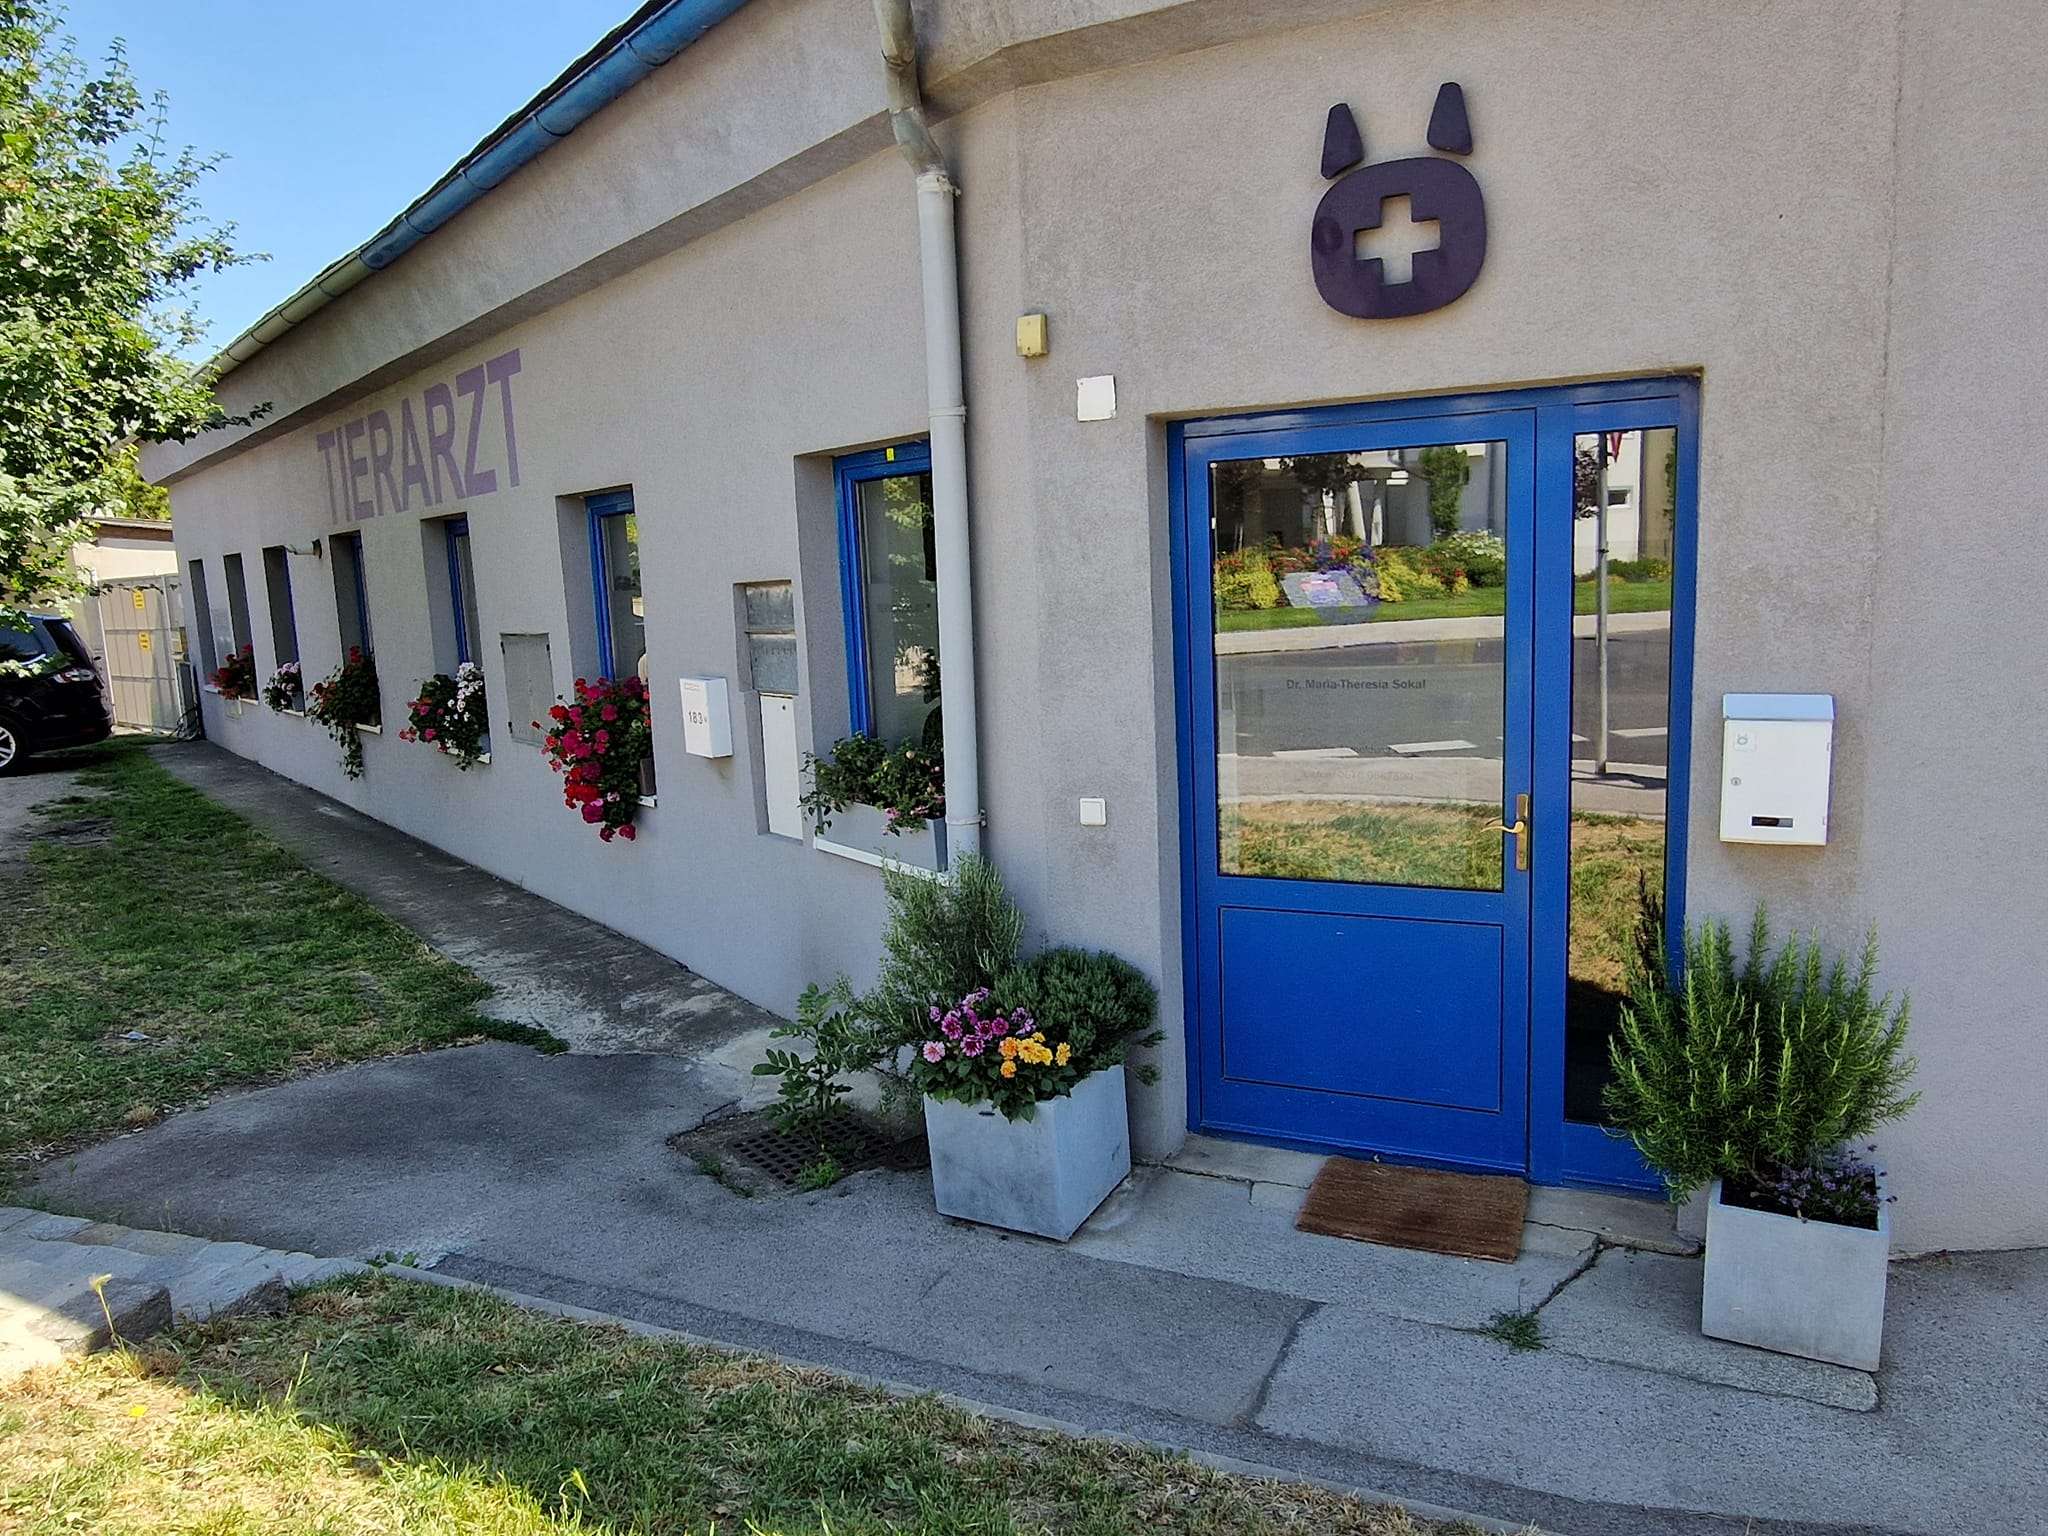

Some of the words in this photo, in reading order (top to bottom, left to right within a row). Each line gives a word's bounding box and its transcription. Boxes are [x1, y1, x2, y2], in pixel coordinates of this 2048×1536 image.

[316, 348, 522, 524] TIERARZT
[1305, 679, 1389, 690] Maria-Theresia
[1392, 679, 1426, 690] Sokal
